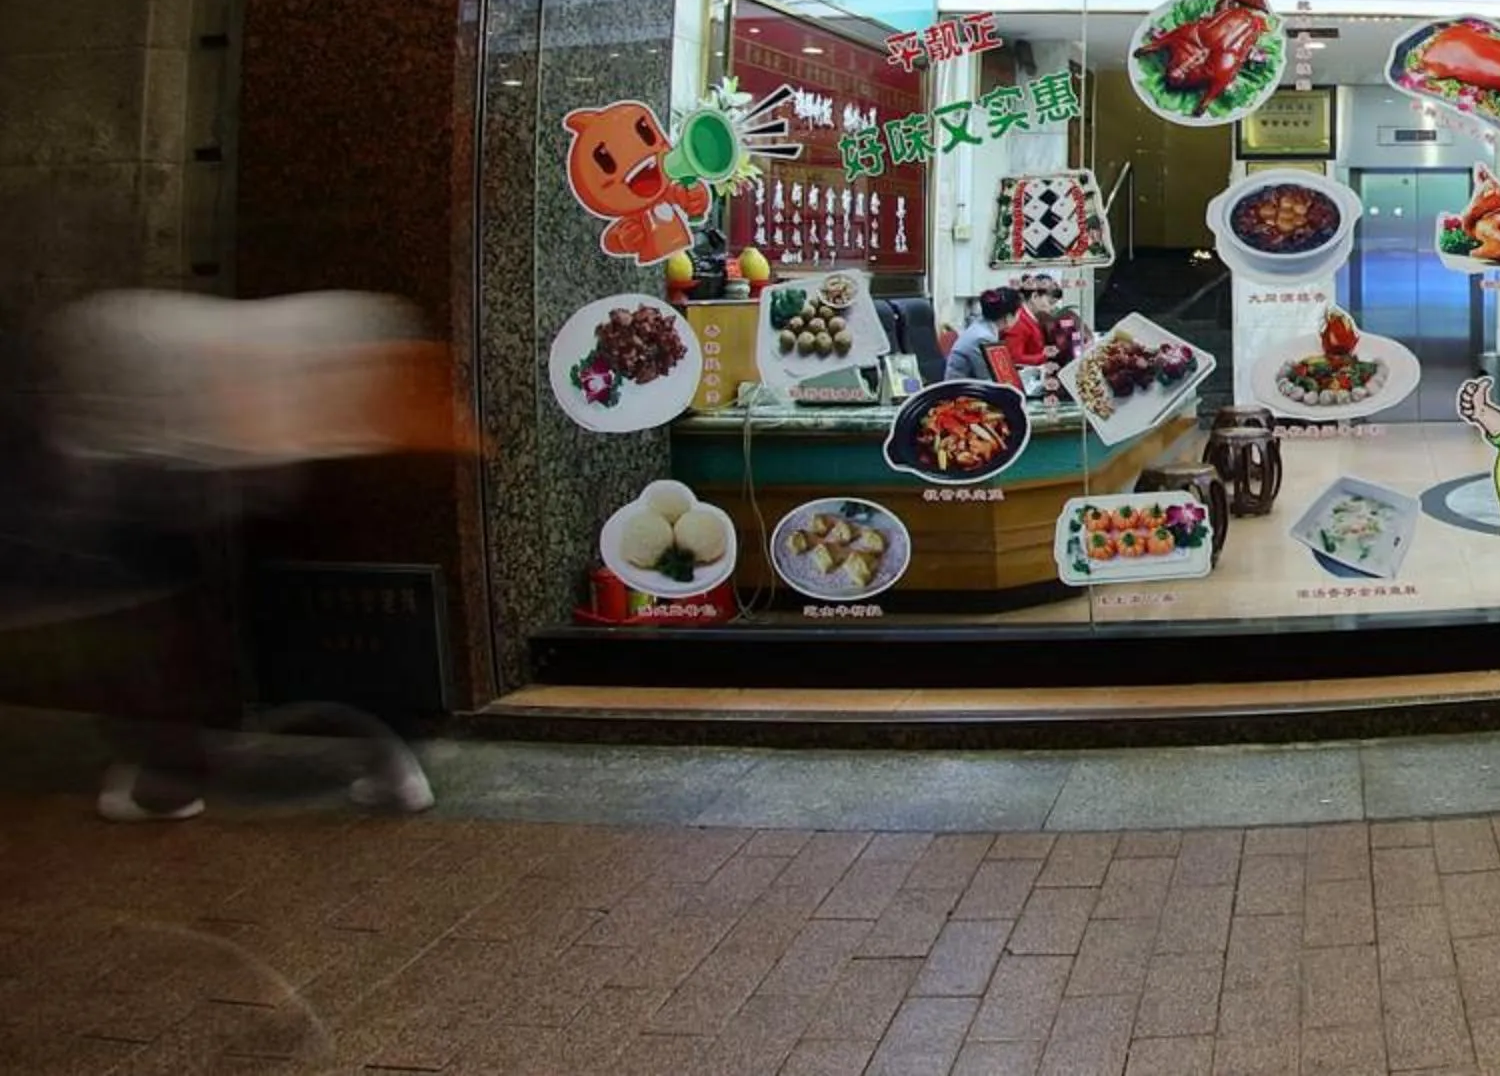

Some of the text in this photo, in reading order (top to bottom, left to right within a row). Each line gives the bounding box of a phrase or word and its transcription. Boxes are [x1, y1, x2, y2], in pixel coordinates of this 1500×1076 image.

[885, 12, 1003, 72] 平靓正
[839, 71, 1081, 182] 好味又实惠
